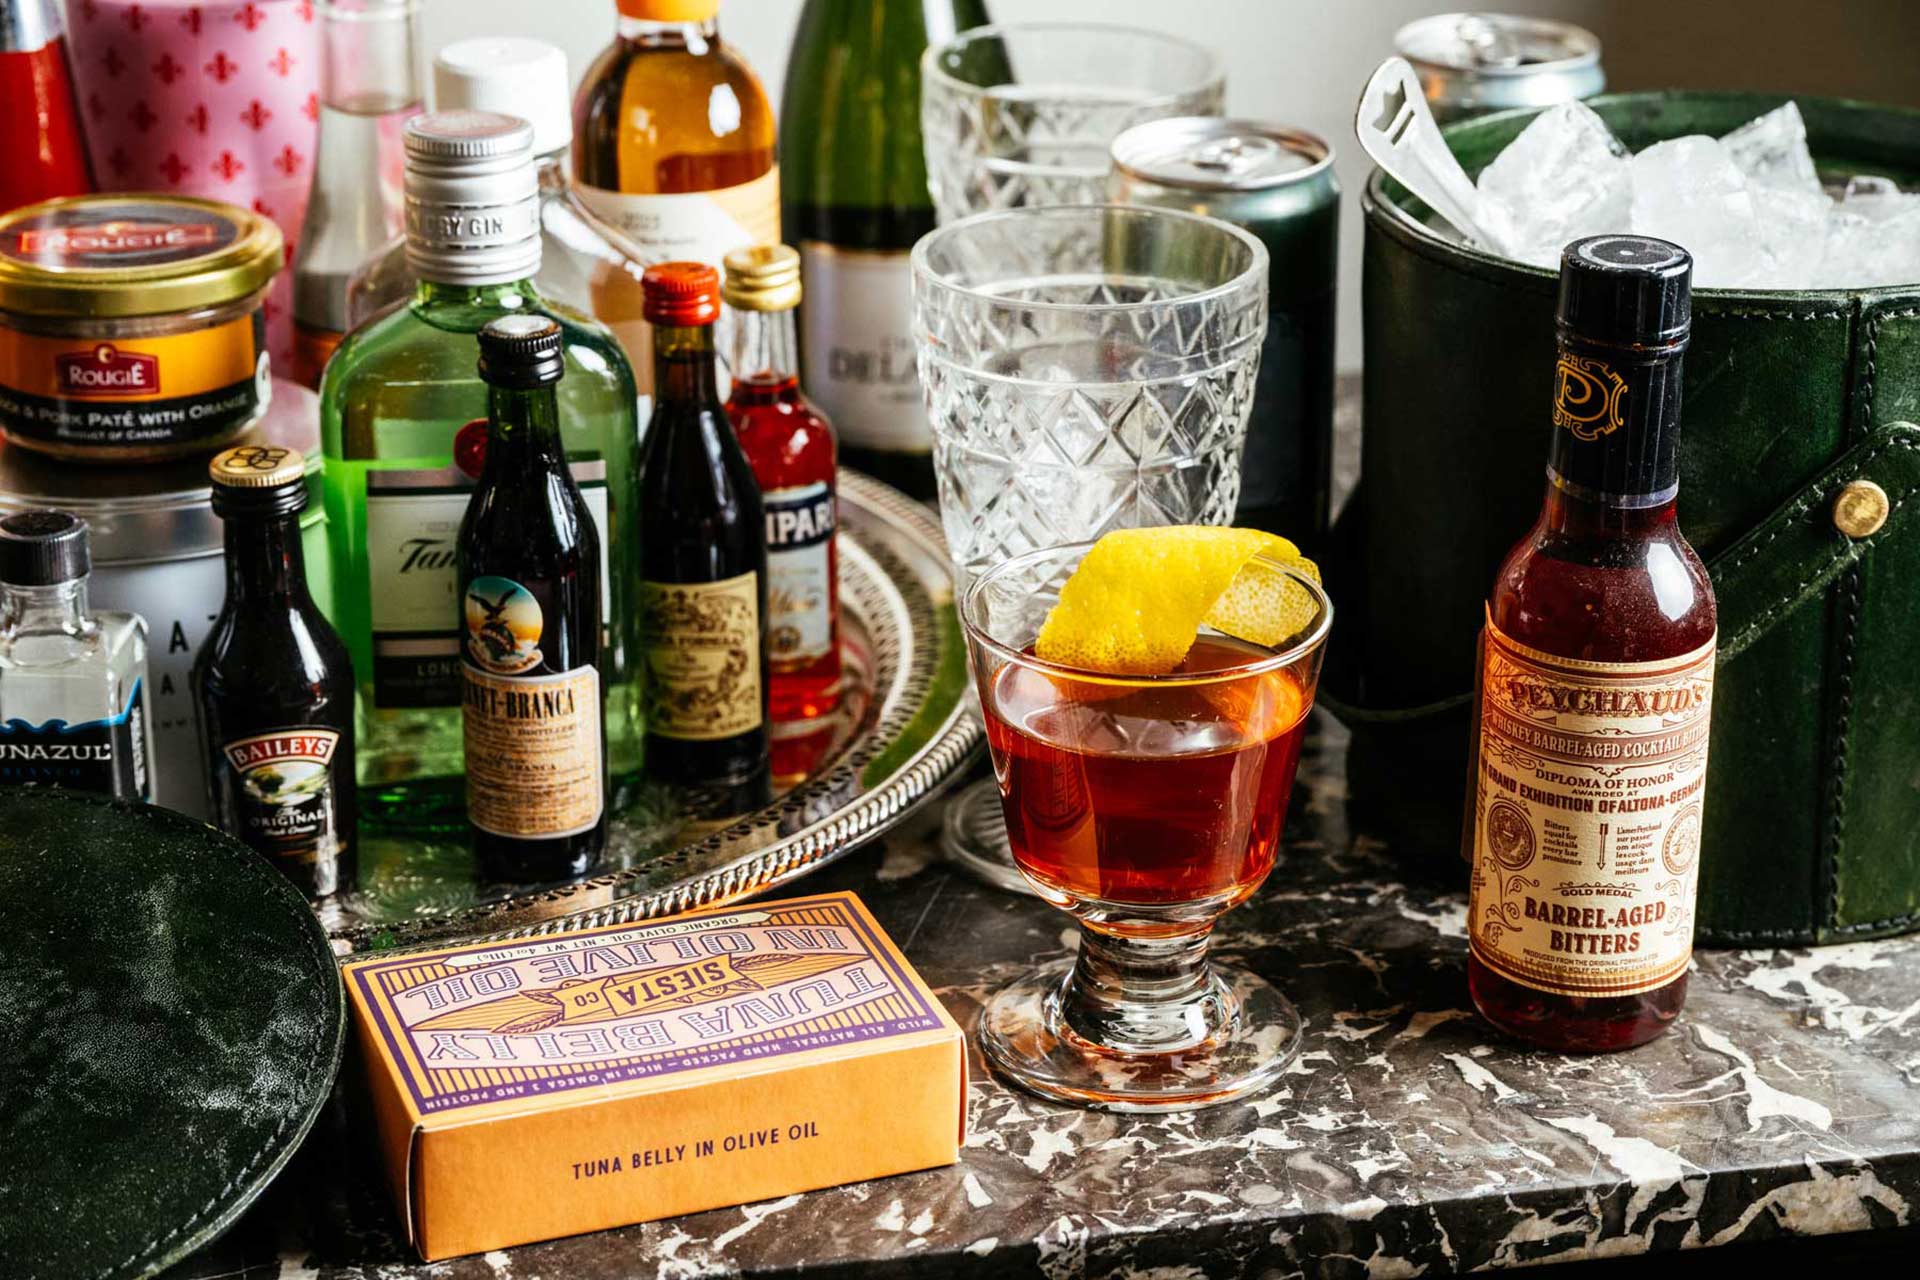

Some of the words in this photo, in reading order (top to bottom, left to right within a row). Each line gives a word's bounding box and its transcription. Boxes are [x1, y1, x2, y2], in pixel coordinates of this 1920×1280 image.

[469, 218, 503, 236] GIN
[87, 411, 134, 428] PATÉ
[138, 409, 185, 427] WITH
[126, 428, 172, 441] CANADA
[1507, 681, 1705, 717] PEYCHAUD'S
[1491, 709, 1532, 743] WHISKEY
[1533, 730, 1620, 758] BARREL-AGED
[1624, 735, 1682, 758] COCKTAIL
[233, 738, 331, 765] BAILEYS
[1536, 768, 1602, 789] DIPLOMA
[1604, 779, 1624, 789] OF
[1627, 772, 1675, 789] HONOR
[1487, 764, 1517, 793] GRAND
[1520, 782, 1593, 812] EXHIBITION
[1598, 799, 1617, 813] OF
[1571, 789, 1624, 798] AWARDED
[1627, 790, 1638, 798] AT
[1544, 818, 1570, 831] Bitters
[1544, 830, 1566, 839] equal
[1566, 832, 1577, 840] for
[1542, 846, 1563, 856] every
[1543, 838, 1578, 849] cocktails
[1542, 854, 1583, 866] prominence
[1561, 888, 1593, 897] GOLD
[1595, 889, 1634, 898] MEDAL
[1524, 896, 1666, 929] BARREL-AGED
[639, 926, 677, 939] OLIVE
[676, 916, 740, 934] ORGANIC
[577, 938, 598, 948] NET
[610, 933, 633, 943] OIL
[766, 928, 849, 951] IN
[1550, 929, 1641, 955] BITTERS
[529, 931, 756, 983] OLIVE
[404, 966, 523, 1011] OIL
[616, 960, 727, 1006] SIESTA
[680, 966, 889, 1040] TUNA
[426, 1016, 677, 1061] BELLY
[861, 1027, 886, 1037] ALL
[743, 1042, 782, 1057] HAND
[681, 1051, 737, 1067] PACKED
[606, 1070, 622, 1081] IN
[626, 1062, 663, 1076] HIGH
[532, 1083, 540, 1091] 3
[546, 1073, 599, 1088] OMEGA
[498, 1084, 525, 1097] AND
[425, 1089, 489, 1109] PROTEIN
[571, 1157, 624, 1180] TUNA
[631, 1144, 687, 1169] BELLY
[695, 1140, 714, 1158] IN
[723, 1128, 780, 1152] OLIVE
[787, 1120, 820, 1141] OIL
